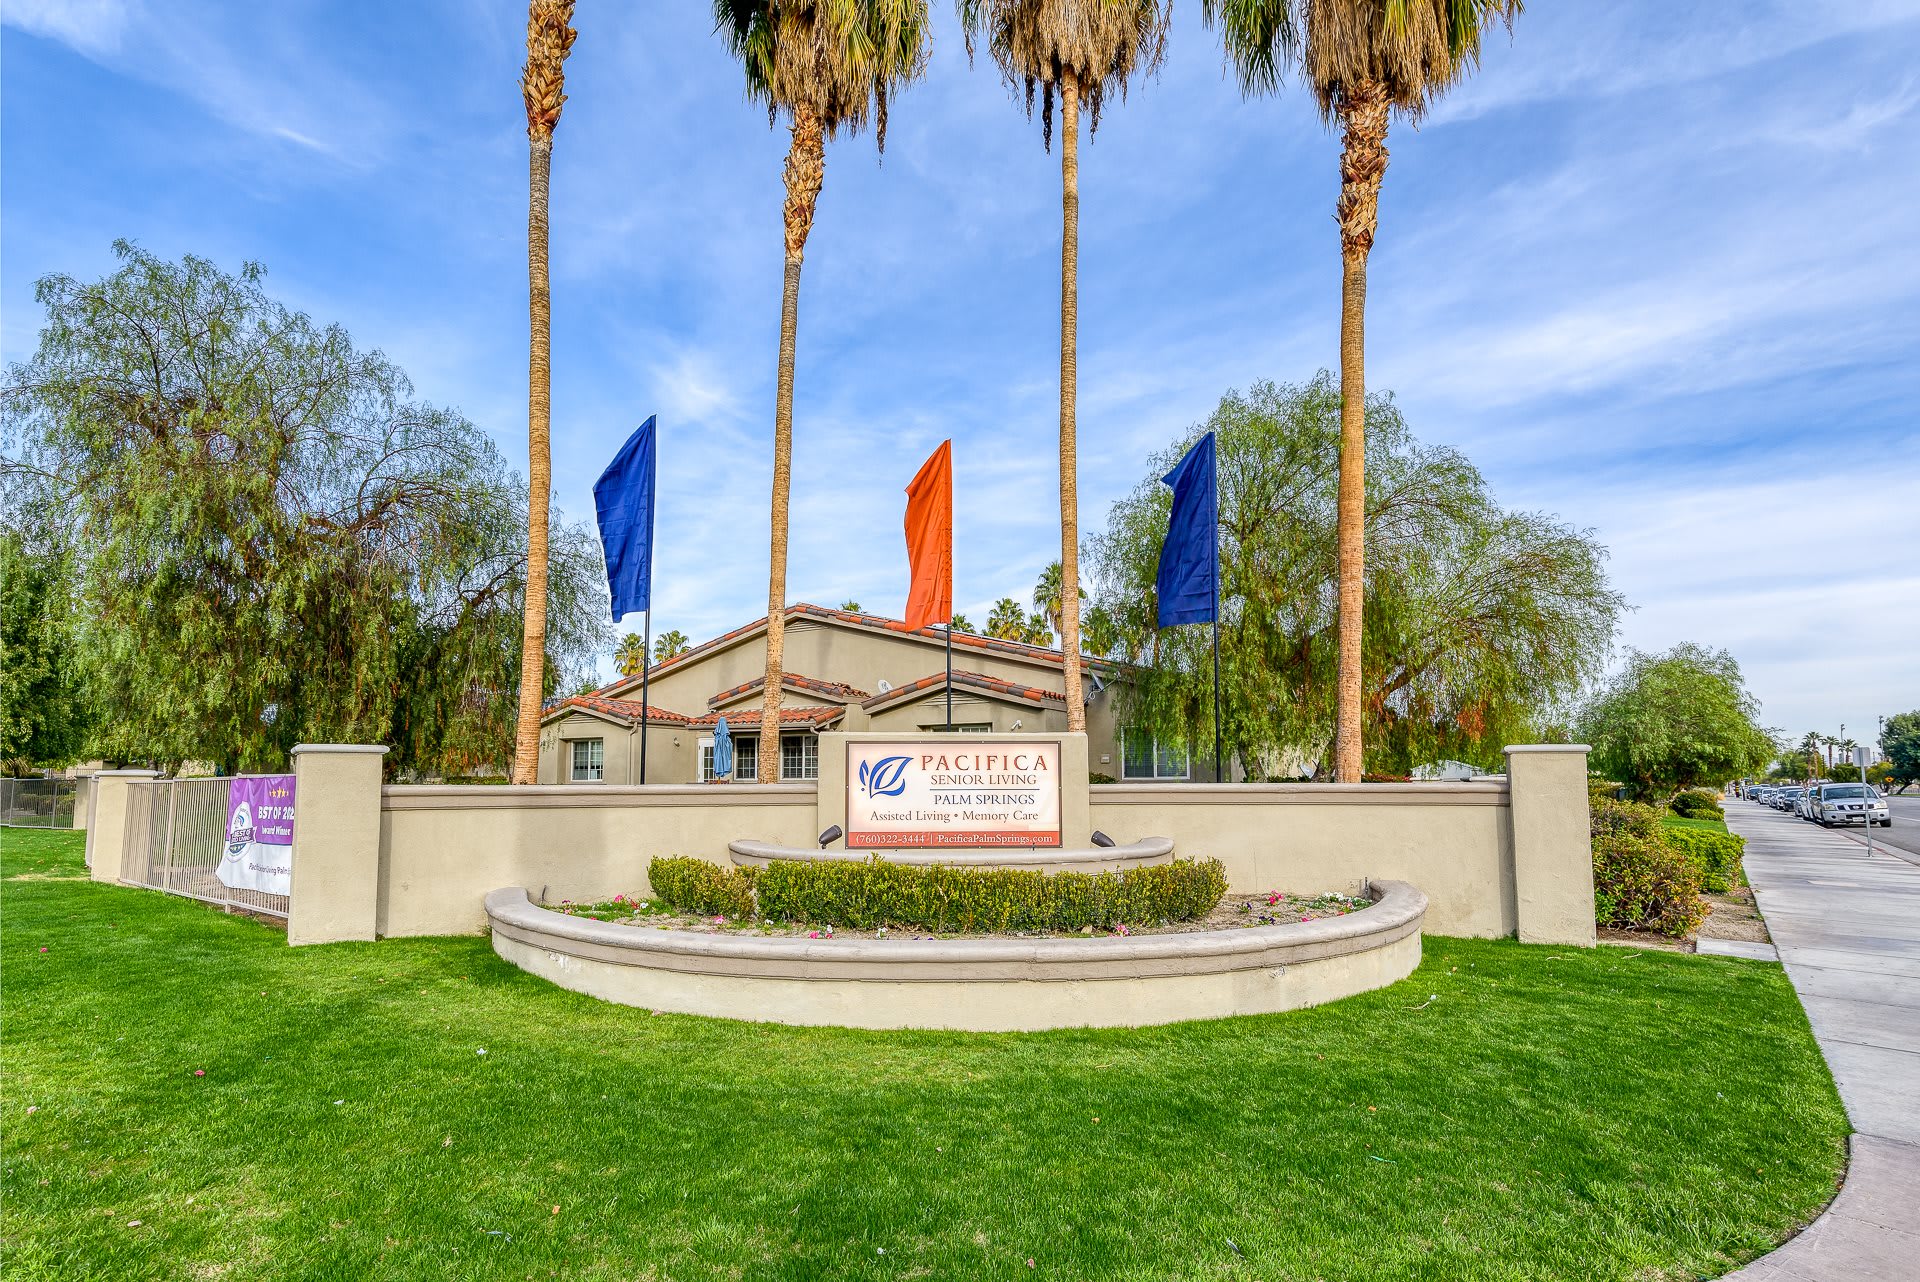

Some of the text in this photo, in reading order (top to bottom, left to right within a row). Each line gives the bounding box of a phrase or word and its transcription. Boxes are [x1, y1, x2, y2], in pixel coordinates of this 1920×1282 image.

[921, 755, 1048, 771] PACIFICA
[930, 774, 1037, 785] SENIOR LIVING
[934, 794, 1035, 805] PALM SPRINGS
[282, 806, 295, 820] 202
[870, 810, 1039, 823] Assisted Living Memory Care
[855, 833, 1053, 845] (760)322-3444 PacificaPalmSprings.com
